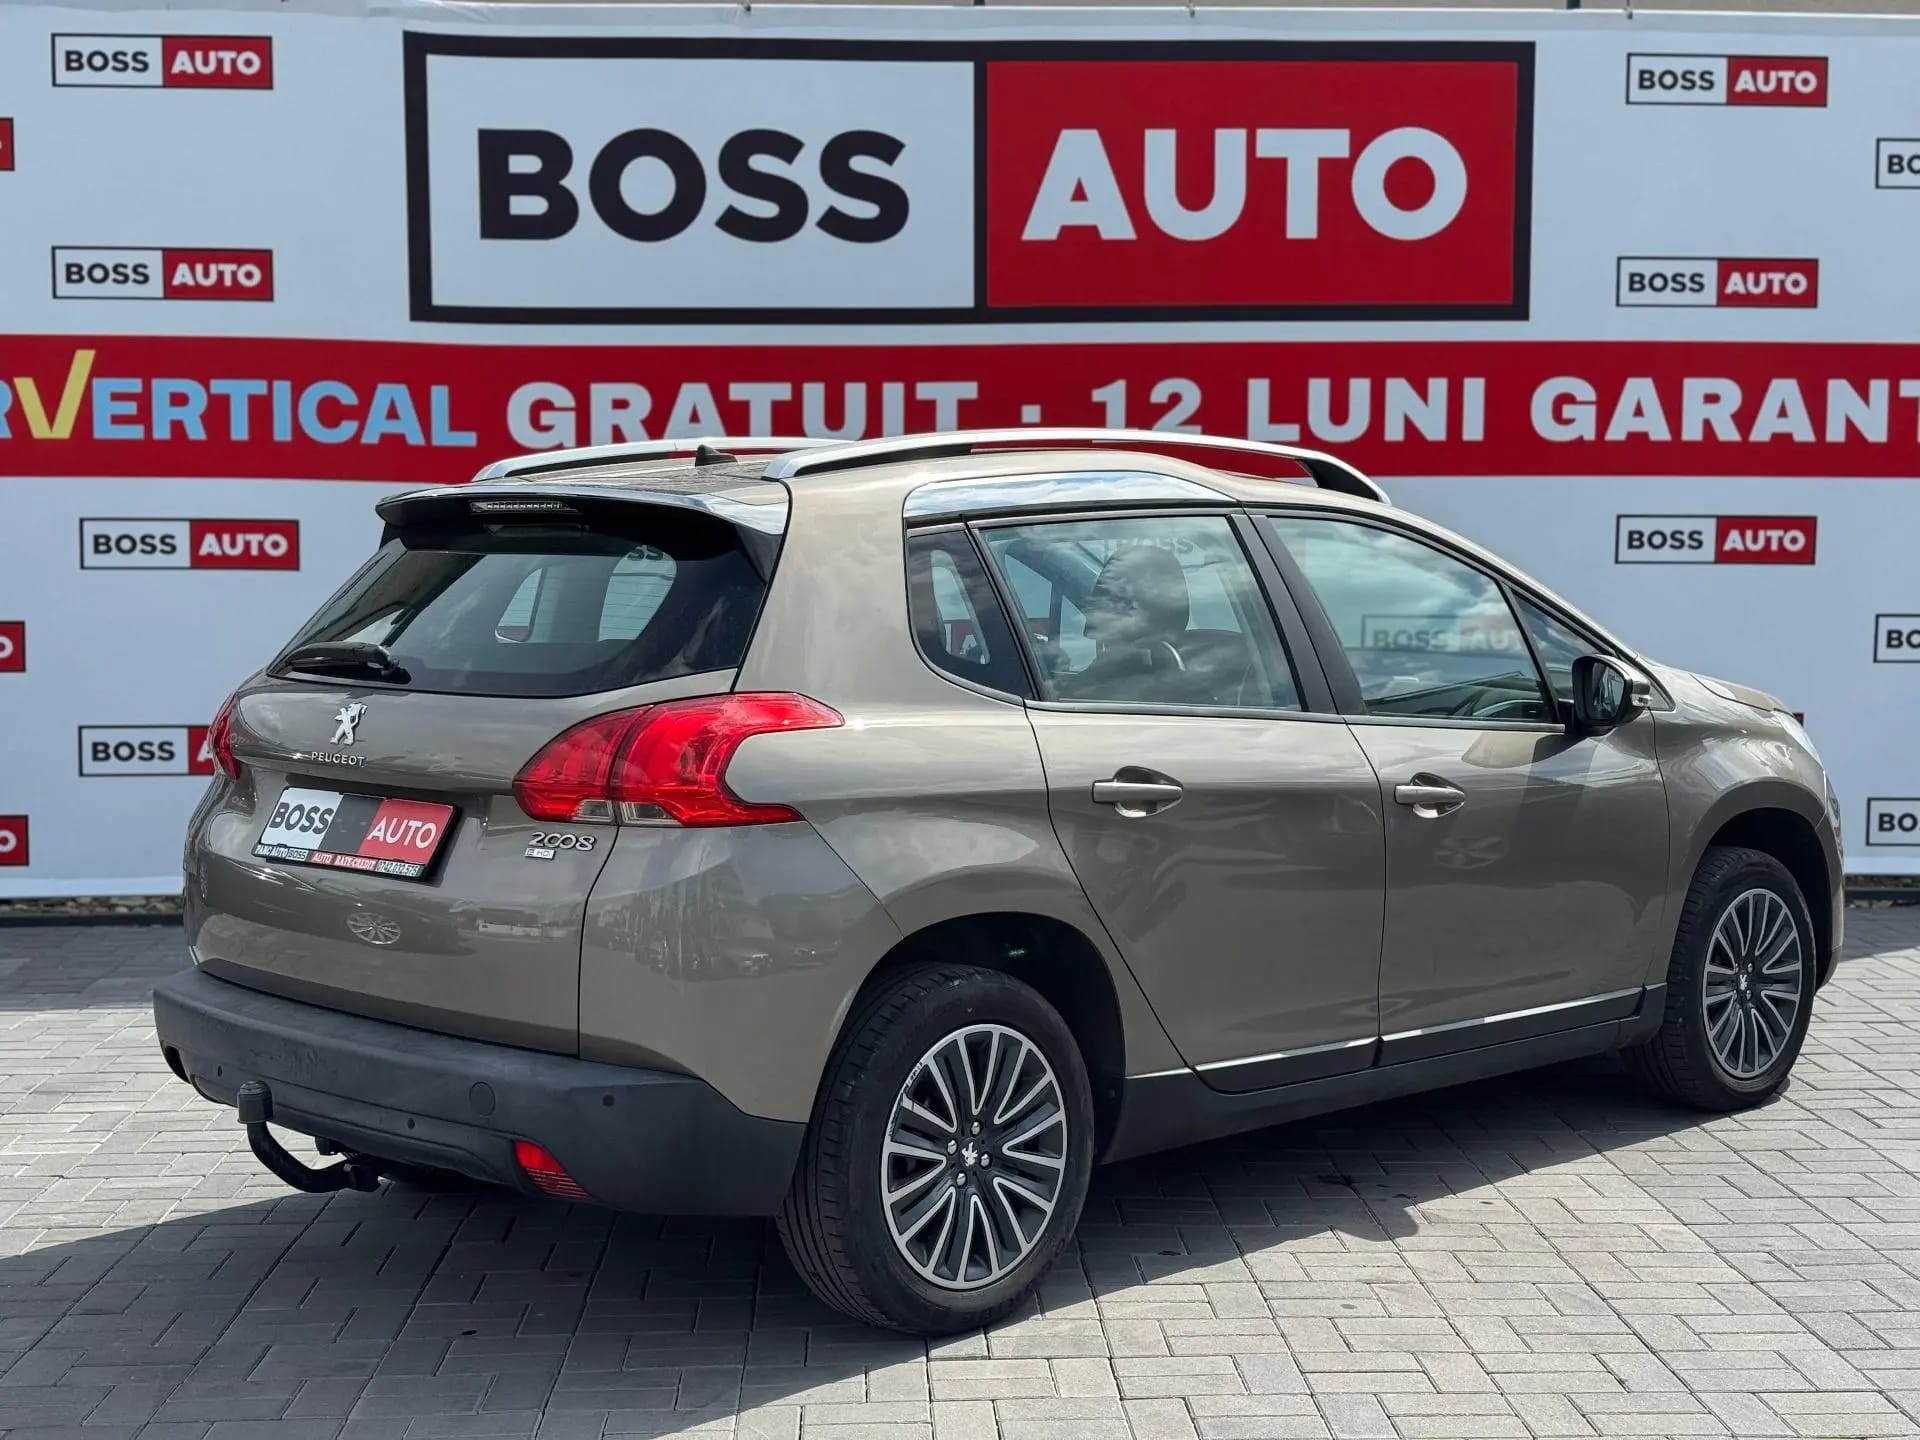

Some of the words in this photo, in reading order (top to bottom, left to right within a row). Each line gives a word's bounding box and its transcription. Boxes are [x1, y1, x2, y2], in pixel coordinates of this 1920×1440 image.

[65, 50, 149, 73] BOSS
[171, 50, 261, 75] AUTO
[1638, 69, 1715, 91] BOSS
[1734, 69, 1817, 93] AUTO
[478, 128, 910, 243] BOSS
[1021, 127, 1467, 241] AUTO
[65, 262, 150, 285] BOSS
[171, 262, 261, 287] AUTO
[1628, 272, 1705, 293] BOSS
[1724, 271, 1807, 295] AUTO
[0, 349, 476, 446] VERTICAL
[506, 381, 978, 449] GRATUIT
[1091, 377, 1202, 435] 12
[1247, 377, 1485, 441] LUNI
[93, 533, 177, 555] BOSS
[198, 533, 288, 557] AUTO
[1628, 529, 1704, 550] BOSS
[1722, 529, 1806, 552] AUTO
[91, 741, 175, 762] BOSS
[311, 751, 366, 767] PEUGEOT
[268, 801, 335, 835] BOSS
[367, 816, 438, 849] AUTO
[528, 831, 596, 851] 2008
[287, 847, 309, 861] BOSS
[312, 851, 333, 864] AUTO
